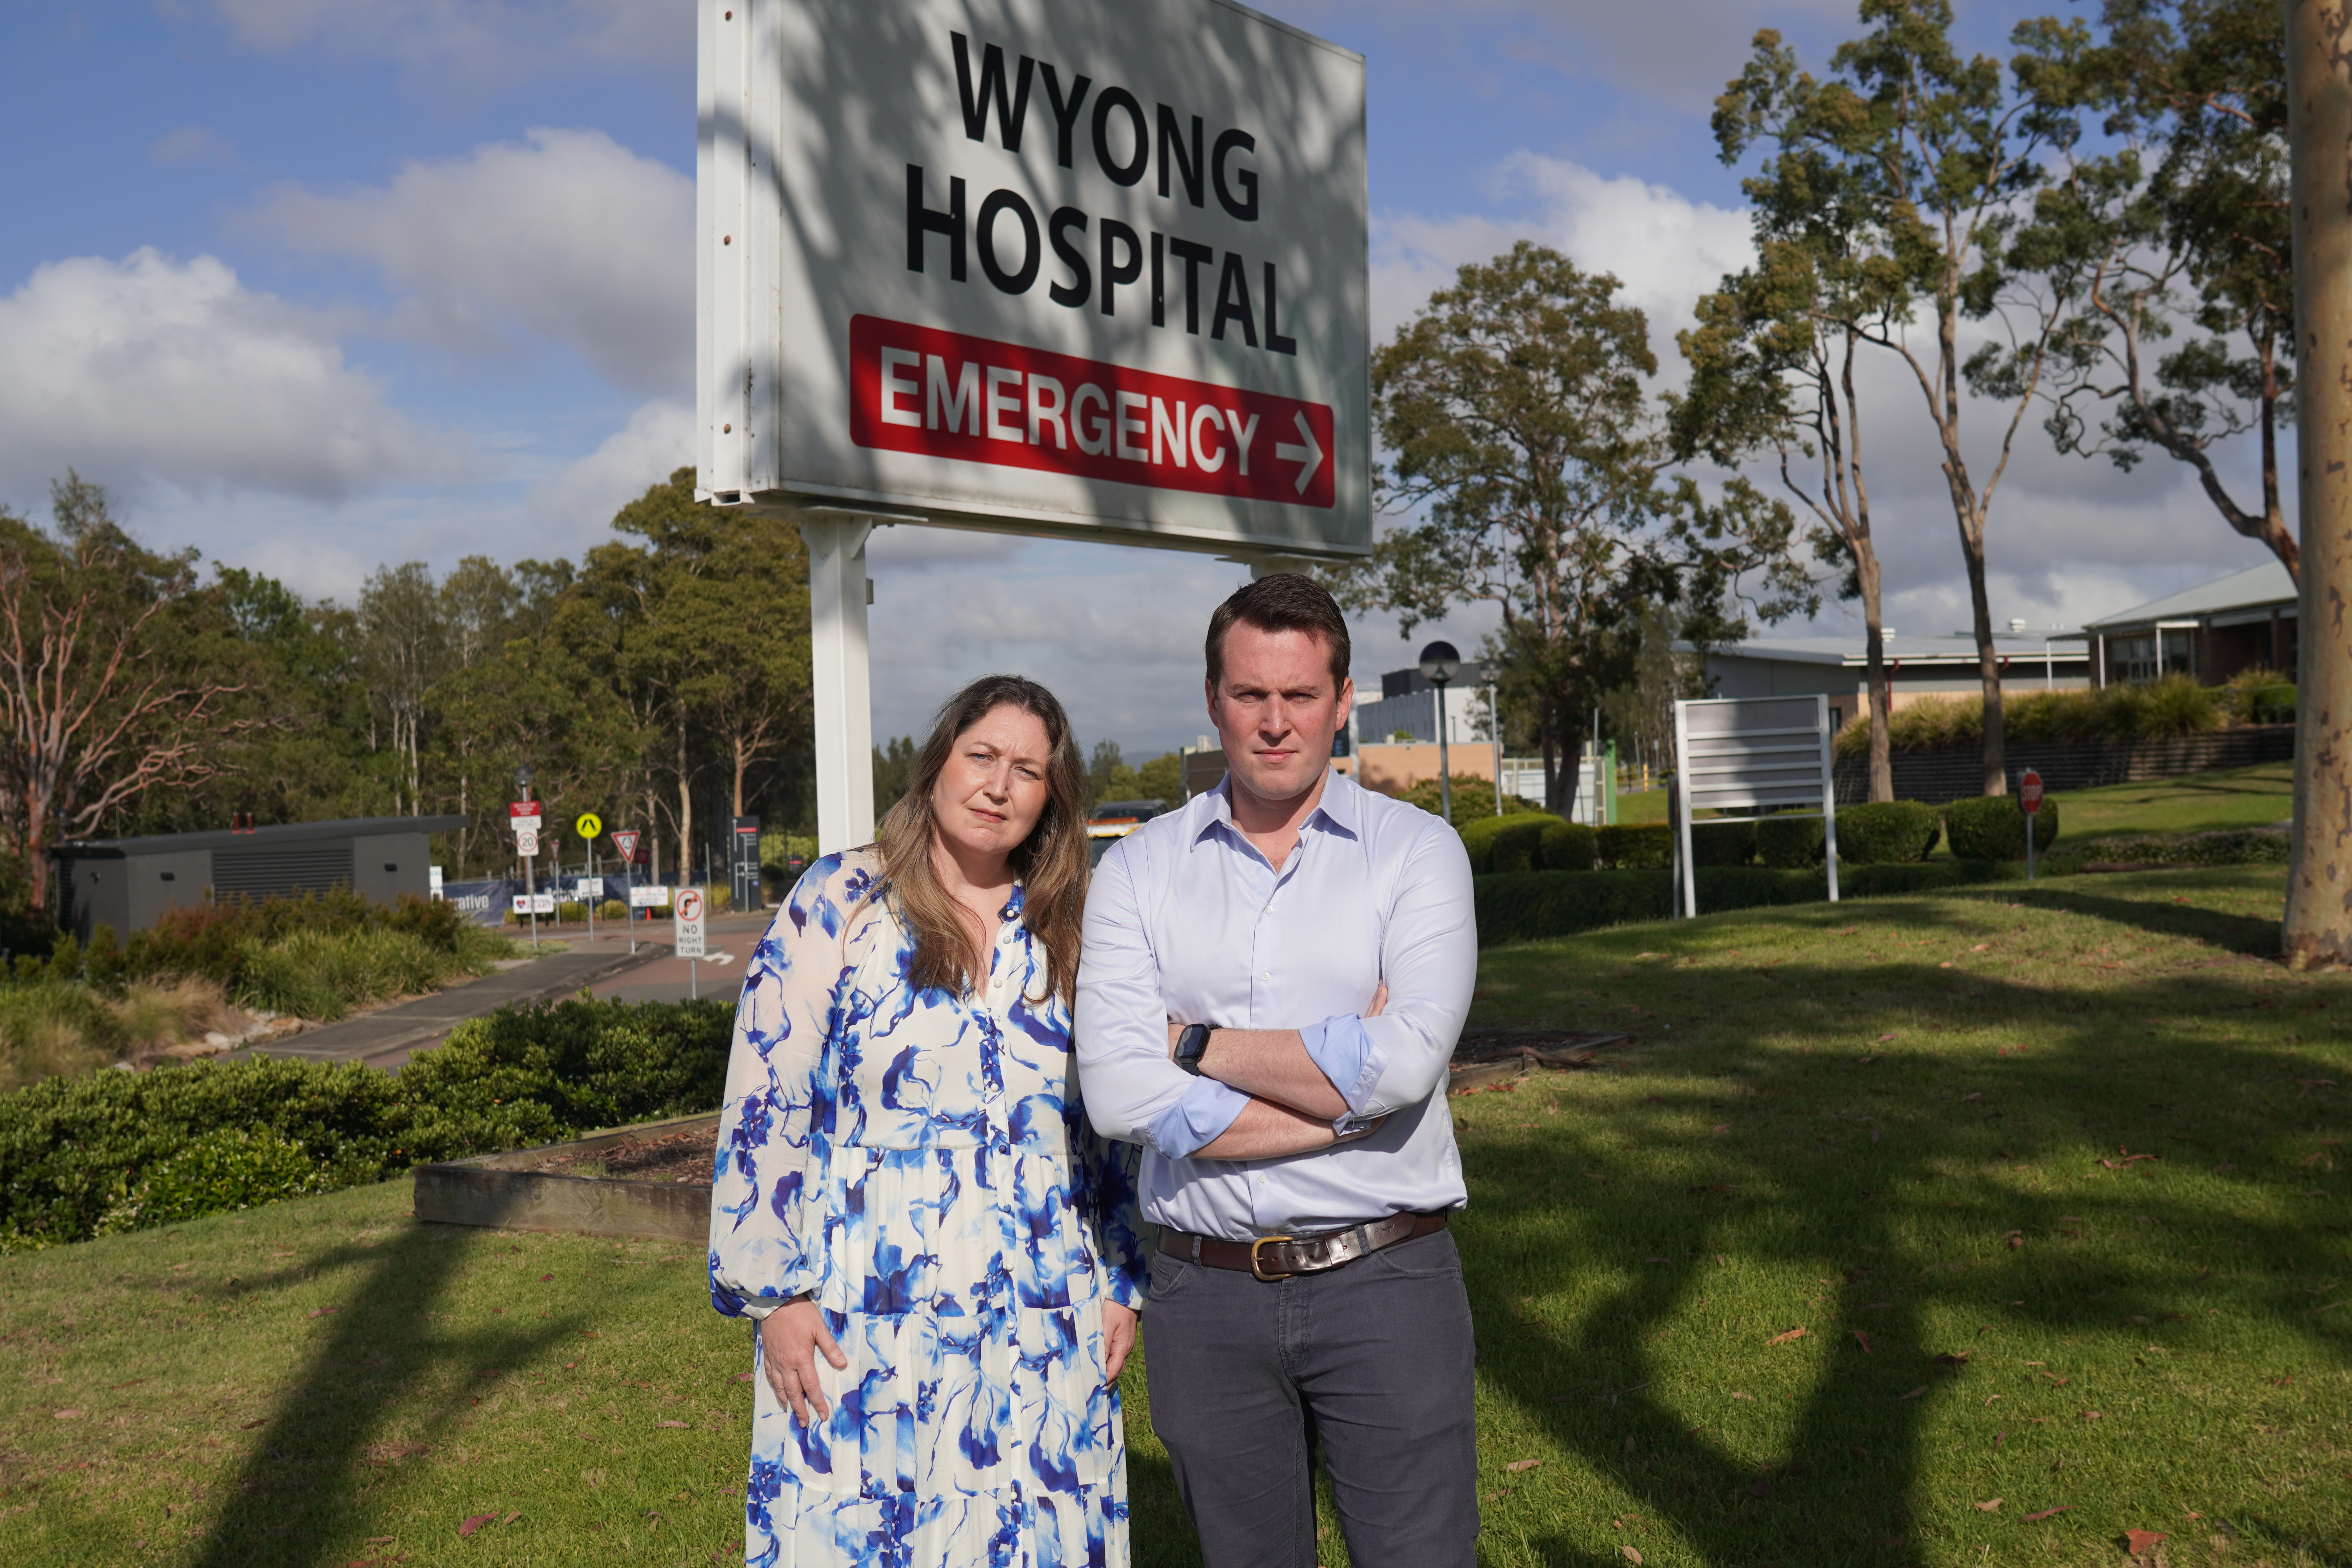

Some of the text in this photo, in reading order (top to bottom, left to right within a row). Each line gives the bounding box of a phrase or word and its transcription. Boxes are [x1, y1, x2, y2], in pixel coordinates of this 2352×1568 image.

[950, 30, 1259, 223] WYONG
[906, 163, 1297, 356] HOSPITAL
[880, 346, 1260, 476] EMERGENCY
[2022, 785, 2042, 801] STOP
[523, 837, 533, 846] 20
[683, 925, 697, 934] NO
